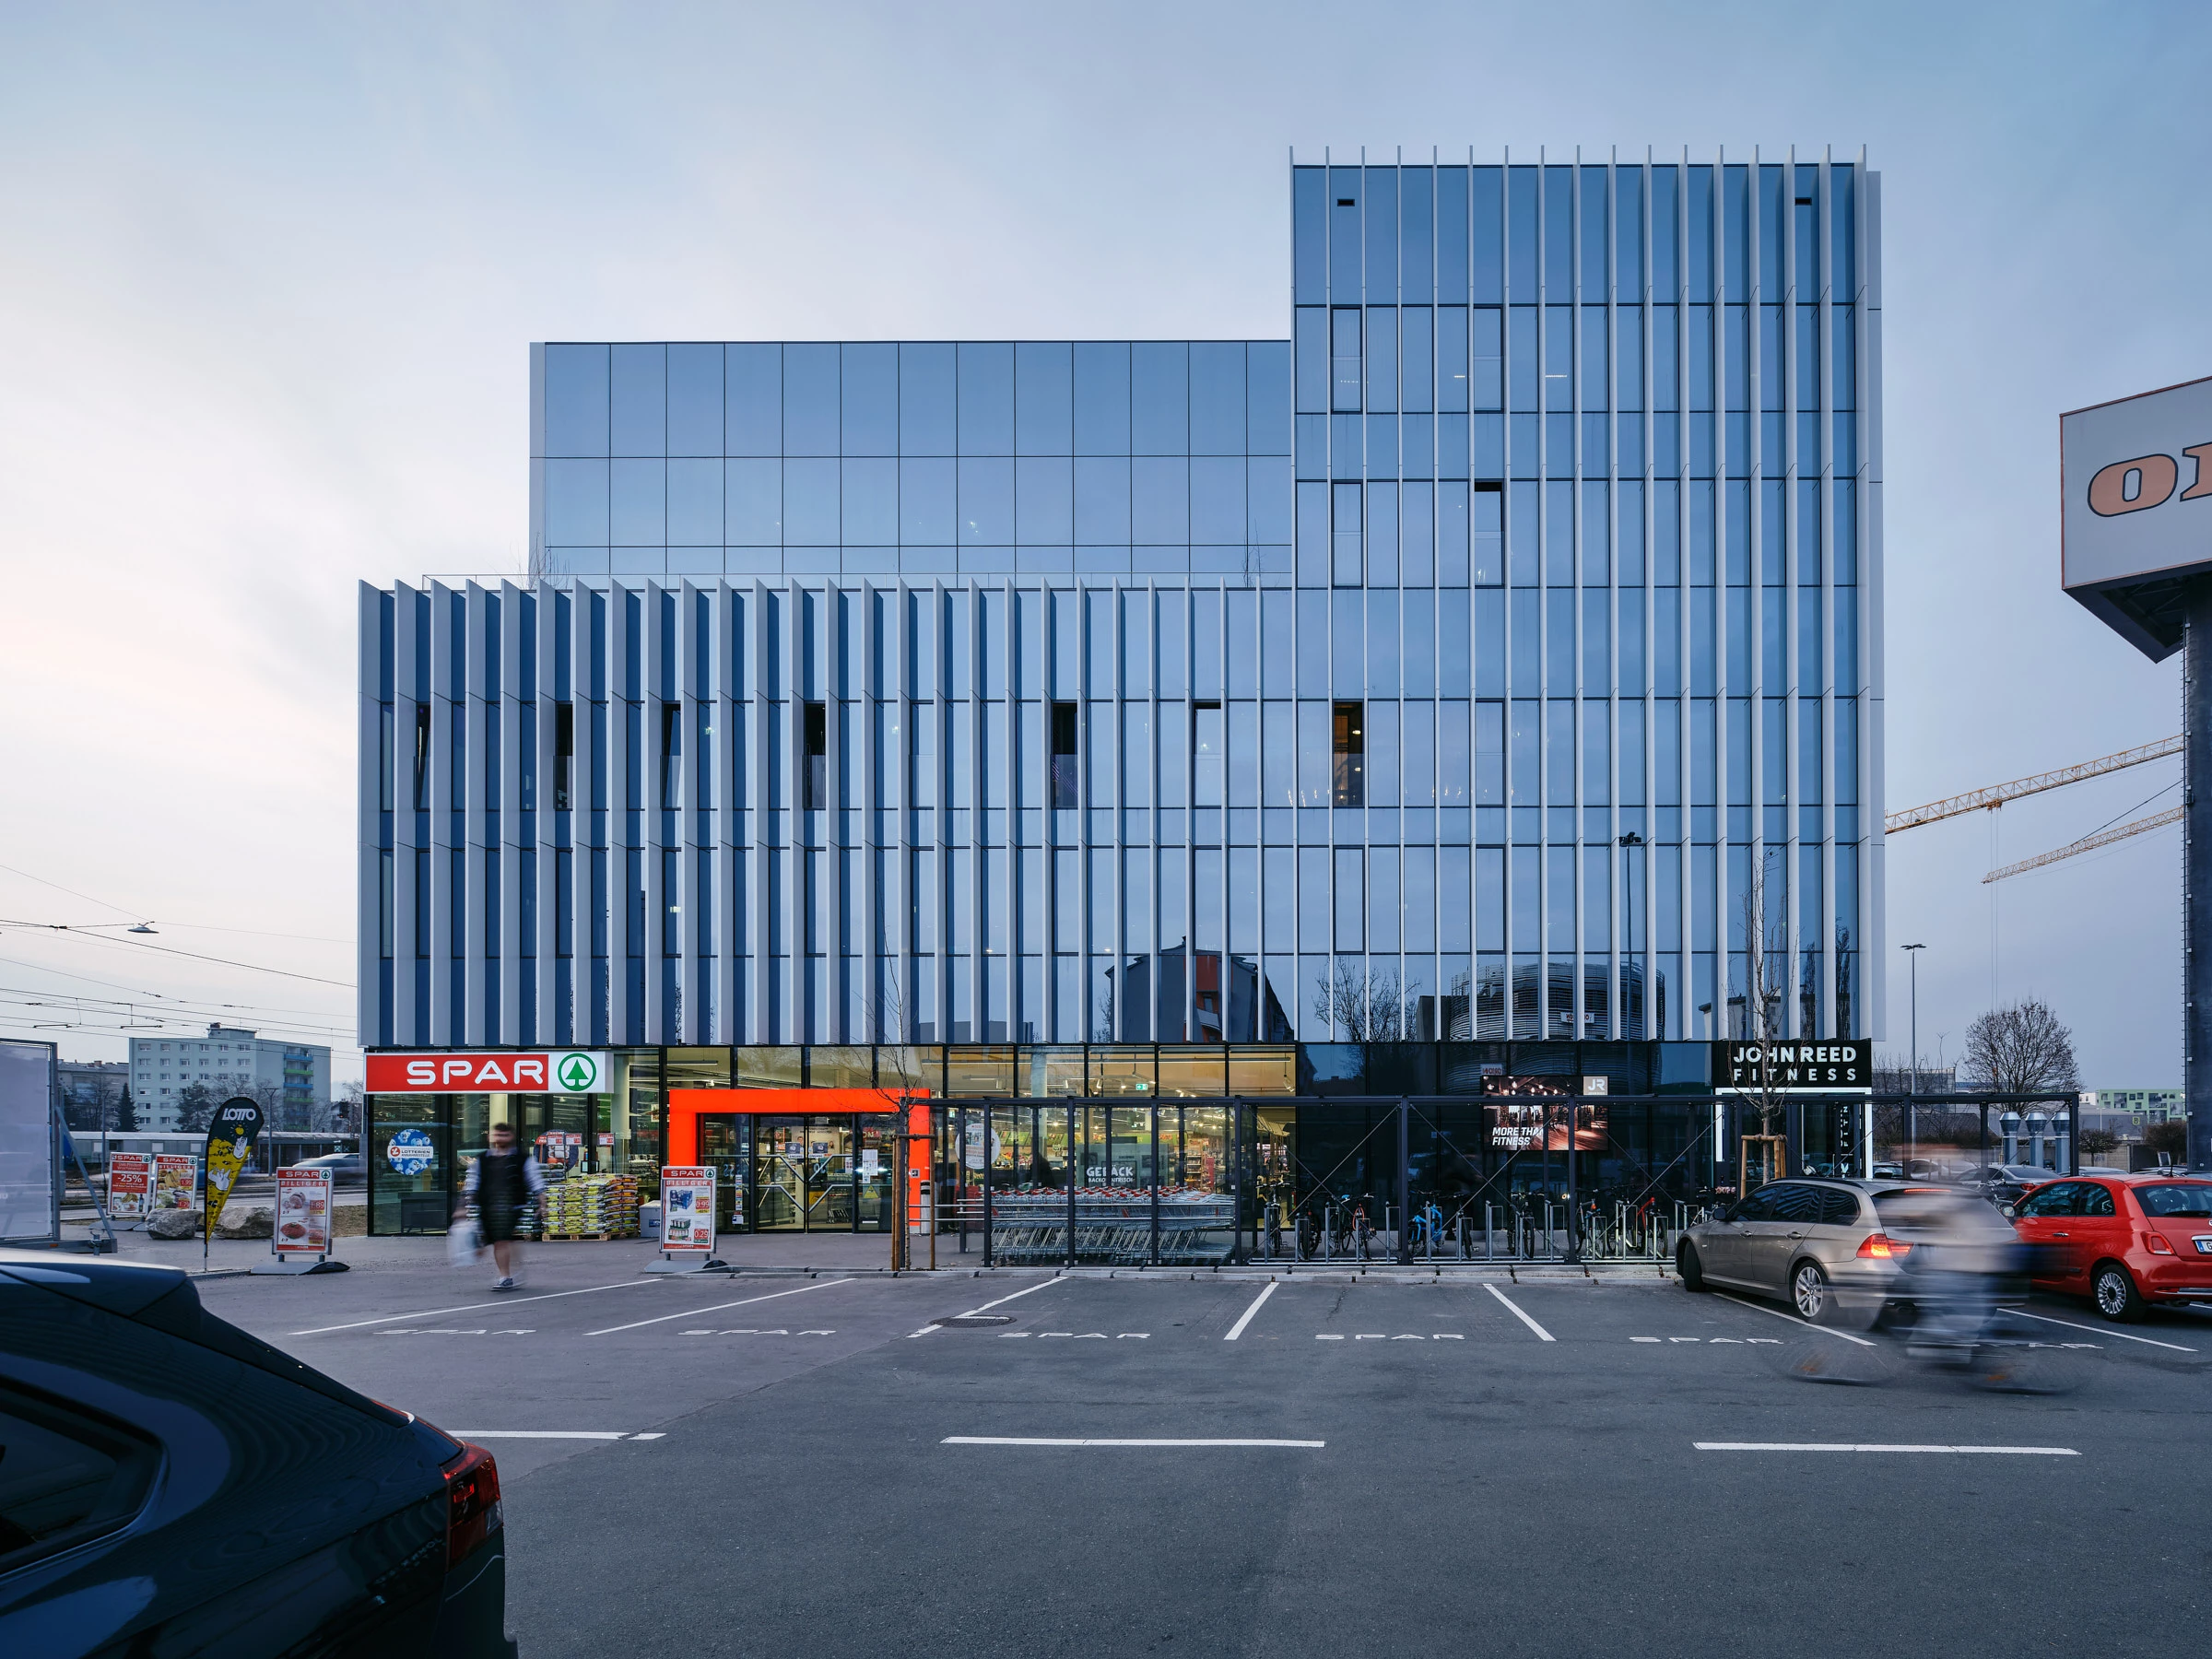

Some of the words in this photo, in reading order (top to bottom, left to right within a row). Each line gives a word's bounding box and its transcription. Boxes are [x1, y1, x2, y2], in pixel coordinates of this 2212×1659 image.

[1734, 1046, 1794, 1063] JOHN
[1800, 1046, 1857, 1063] REED
[406, 1060, 544, 1085] SPAR
[1734, 1068, 1856, 1081] FITNESS
[1588, 1078, 1606, 1091] JR
[221, 1108, 256, 1121] LOTTO
[1492, 1126, 1519, 1135] MORE
[1492, 1136, 1530, 1146] FITNESS
[117, 1173, 142, 1183] -25%
[1629, 1336, 1784, 1345] SPAR
